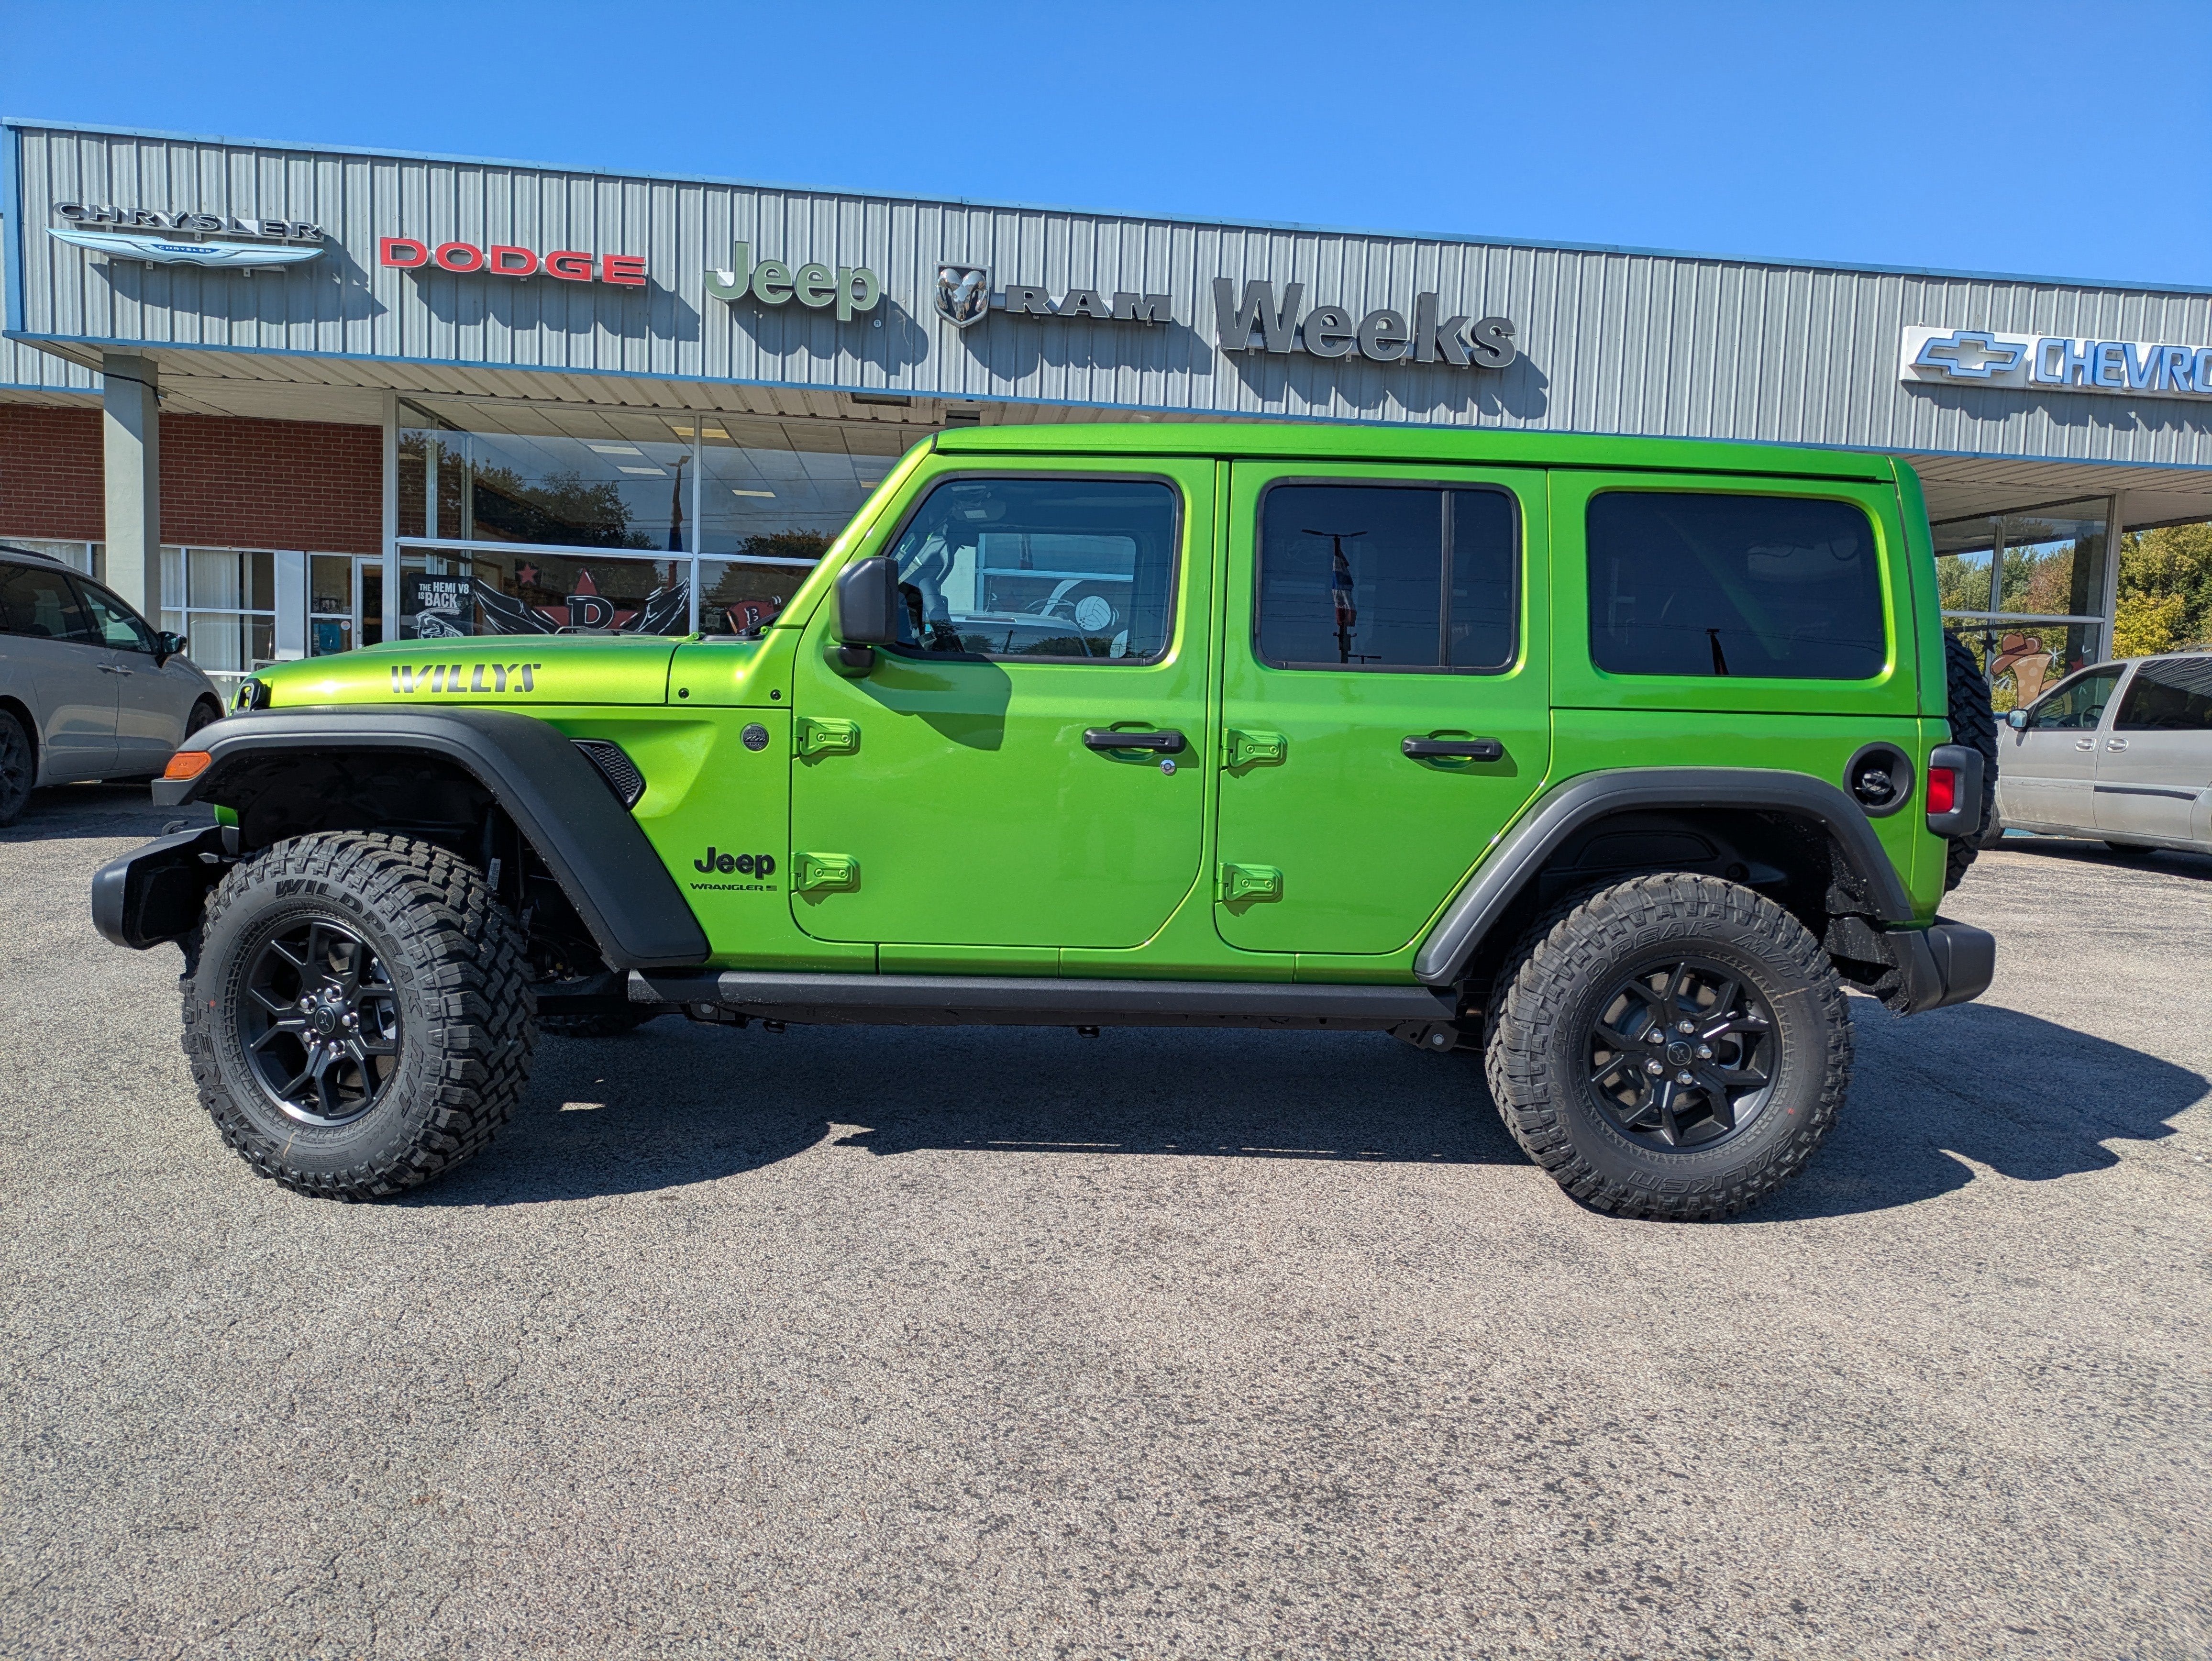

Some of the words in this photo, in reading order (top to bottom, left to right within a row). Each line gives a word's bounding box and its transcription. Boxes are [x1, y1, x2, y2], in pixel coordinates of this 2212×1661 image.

[53, 201, 321, 239] CHRYSLER
[380, 236, 646, 286] DODGE
[704, 241, 880, 321] Jeep
[1005, 285, 1172, 322] RAM
[1213, 277, 1516, 369] Weeks
[419, 583, 431, 591] THE
[433, 582, 456, 593] HEMI
[458, 583, 469, 594] V8
[425, 592, 458, 608] BACK
[391, 664, 542, 693] WILLYS
[694, 846, 775, 879] Jeep
[690, 883, 764, 891] WRANGLER
